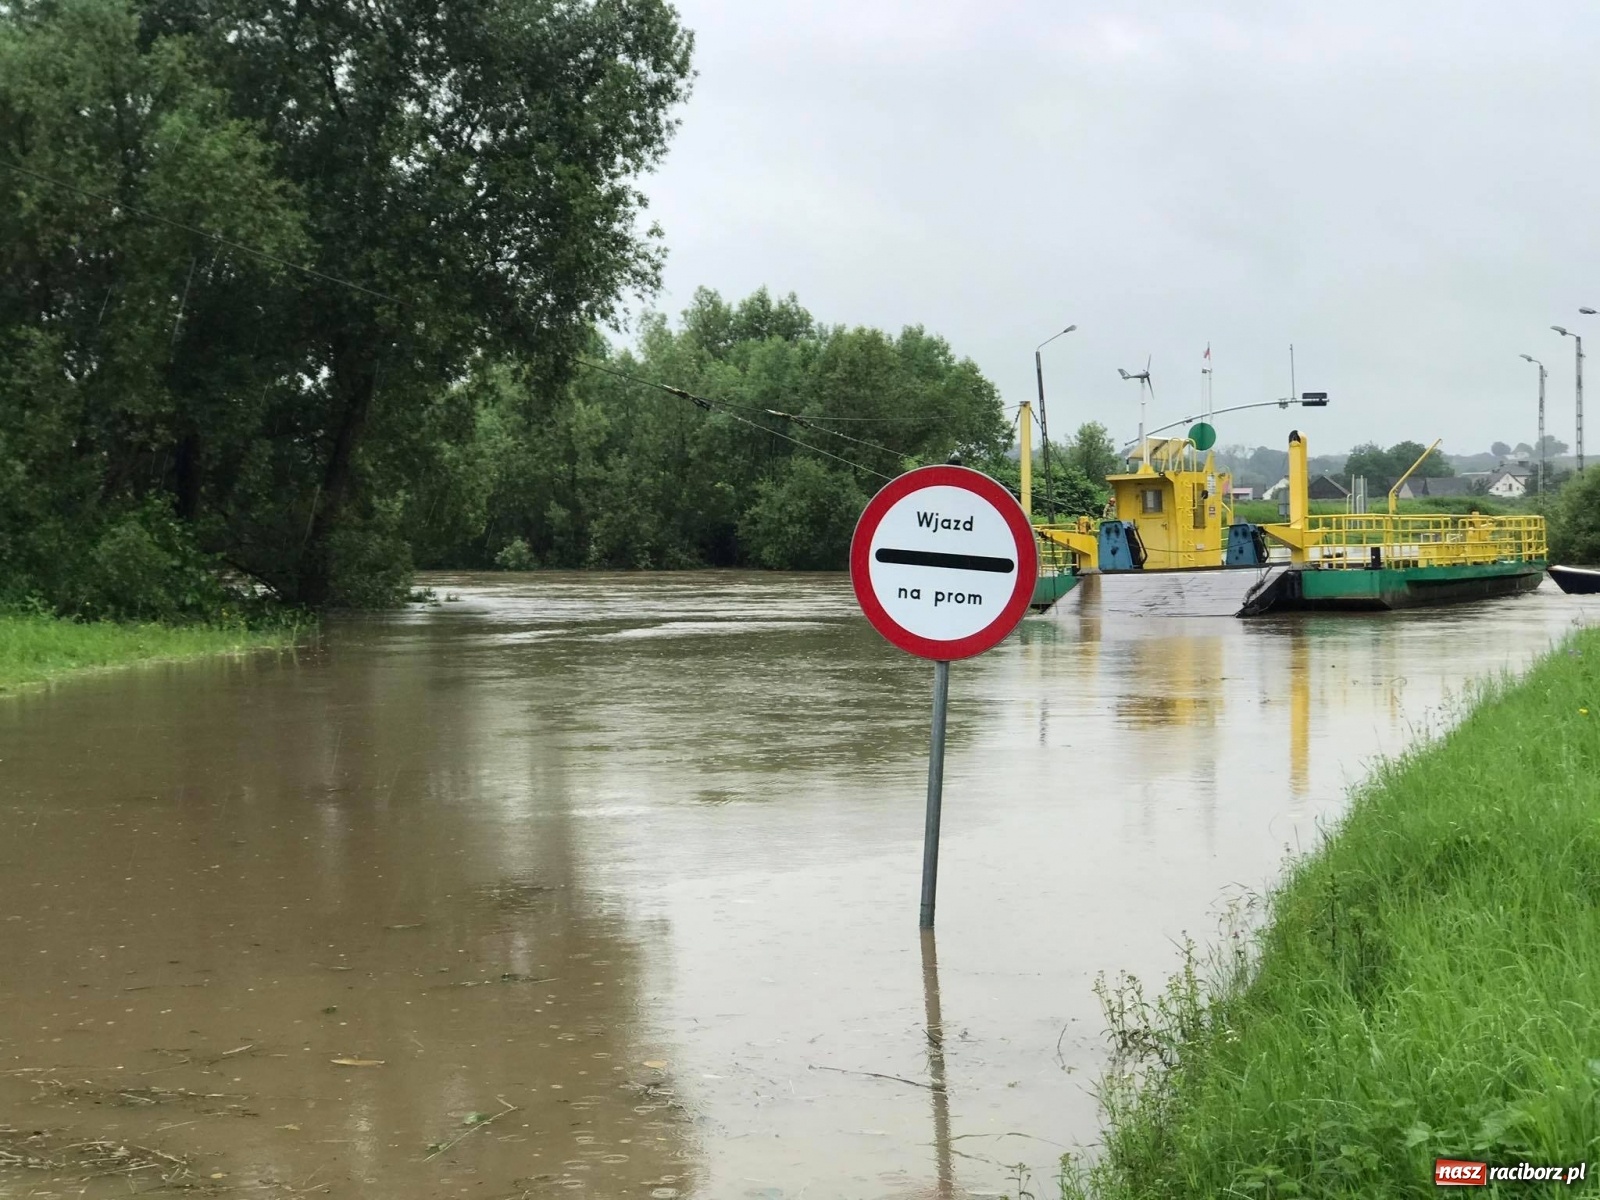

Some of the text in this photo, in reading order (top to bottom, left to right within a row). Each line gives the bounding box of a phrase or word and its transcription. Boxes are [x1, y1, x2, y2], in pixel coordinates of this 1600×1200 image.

[916, 511, 974, 533] Wjazd
[898, 587, 983, 607] na prom
